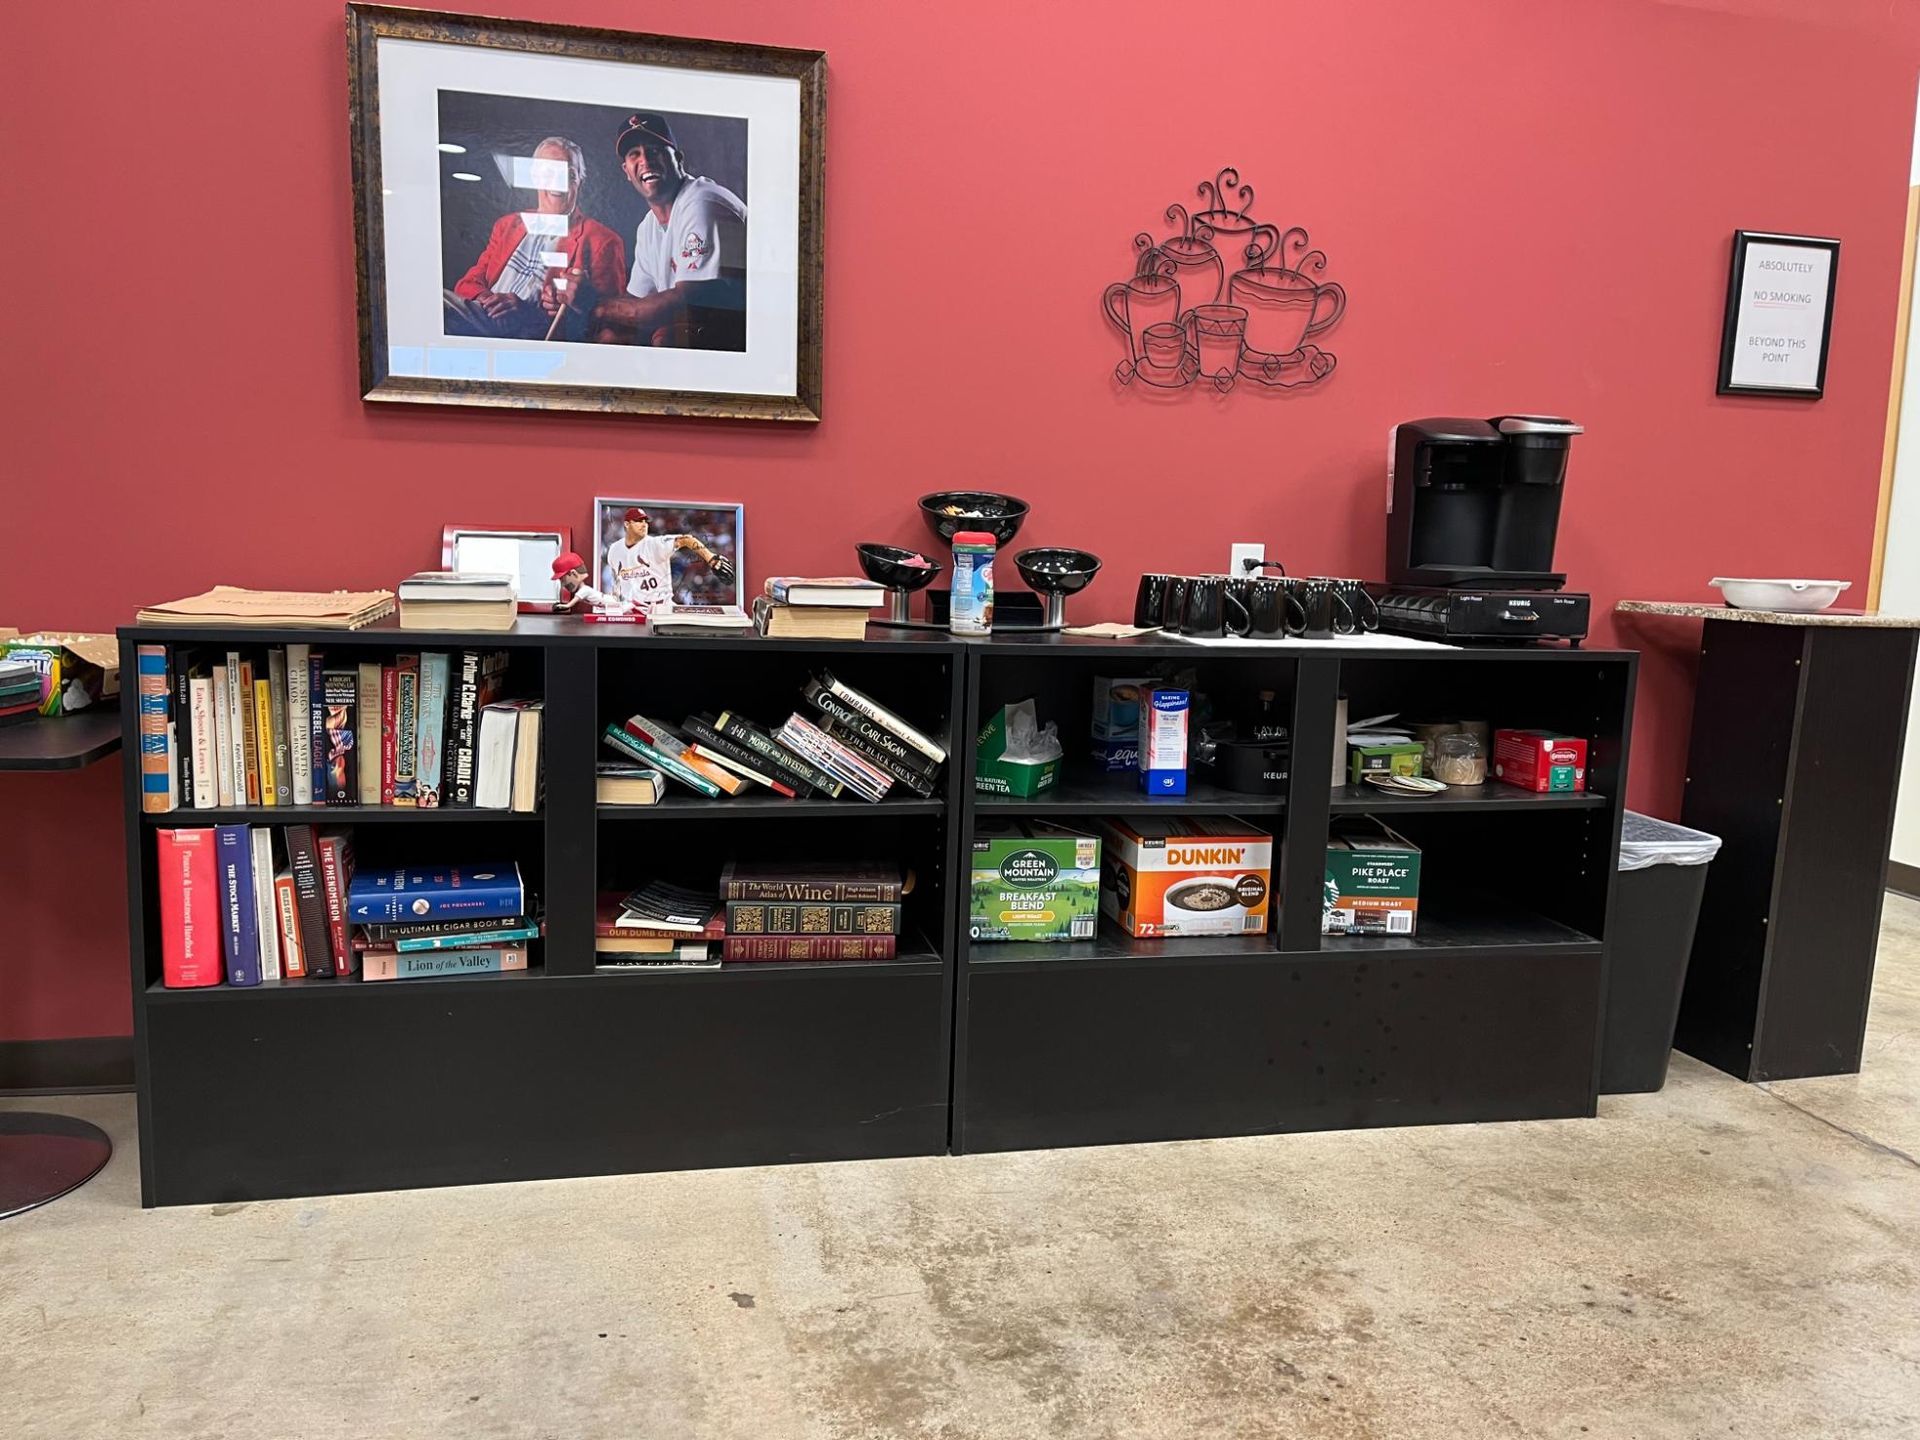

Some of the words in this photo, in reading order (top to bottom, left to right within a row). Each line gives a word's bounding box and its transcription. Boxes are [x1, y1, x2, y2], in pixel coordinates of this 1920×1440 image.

[1759, 260, 1813, 273] ABSOLUTELY
[1754, 291, 1767, 300] NO
[1770, 291, 1812, 303] SMOKING
[1749, 337, 1785, 347] BEYOND
[1788, 339, 1806, 348] THIS
[1763, 353, 1790, 362] POINT
[640, 577, 657, 591] 40
[463, 655, 478, 684] Arthur
[151, 678, 164, 701] TOM
[289, 669, 298, 704] CHAOS
[195, 688, 205, 706] Eats,
[300, 690, 308, 714] SIGN
[461, 691, 476, 719] Clarke
[838, 690, 876, 718] COMRADES
[196, 710, 206, 736] Shoots
[313, 709, 322, 734] REBEL
[815, 691, 855, 723] CONTACT
[859, 722, 883, 742] CARL
[879, 734, 908, 758] SAGAN
[152, 707, 165, 760] BROKAW
[298, 724, 307, 740] JIM
[313, 734, 322, 768] LEAGUE
[695, 725, 717, 742] SPACE
[718, 738, 726, 746] IS
[725, 742, 740, 754] THE
[740, 750, 762, 766] PLACE
[199, 748, 208, 775] Leaves
[276, 744, 287, 767] Cigars
[300, 743, 308, 777] MATTIS
[748, 734, 771, 753] MONEY
[779, 753, 813, 778] INVESTING
[847, 734, 865, 748] THE
[864, 745, 890, 765] BLACK
[889, 762, 917, 783] COUNT
[1108, 749, 1138, 766] equ
[456, 748, 472, 784] CRADLE
[984, 777, 1007, 785] NATURAL
[1263, 771, 1288, 779] KEUR
[997, 784, 1010, 793] TEA
[323, 846, 333, 863] THE
[1167, 848, 1245, 865] DUNKIN'
[184, 850, 192, 877] Finance
[228, 864, 236, 878] THE
[1012, 860, 1045, 868] GREEN
[1352, 868, 1374, 876] PIKE
[1004, 868, 1053, 877] MOUNTAIN
[229, 879, 237, 902] STOCK
[326, 864, 341, 921] PHENOMENON
[749, 883, 761, 891] The
[762, 883, 783, 891] World
[779, 891, 786, 900] of
[786, 884, 832, 900] Wine
[1000, 892, 1056, 901] BREAKFAST
[183, 887, 192, 924] Investment
[1011, 901, 1044, 910] BLEND
[230, 904, 239, 933] MARKET
[400, 924, 440, 934] ULTIMATE
[444, 923, 470, 932] CIGAR
[473, 921, 498, 929] BOOK
[657, 930, 696, 939] CENTURY
[1139, 923, 1154, 934] 72
[184, 925, 193, 958] Handbook
[407, 959, 433, 972] Lion
[435, 960, 444, 970] of
[445, 958, 456, 968] the
[459, 956, 491, 968] Valley
